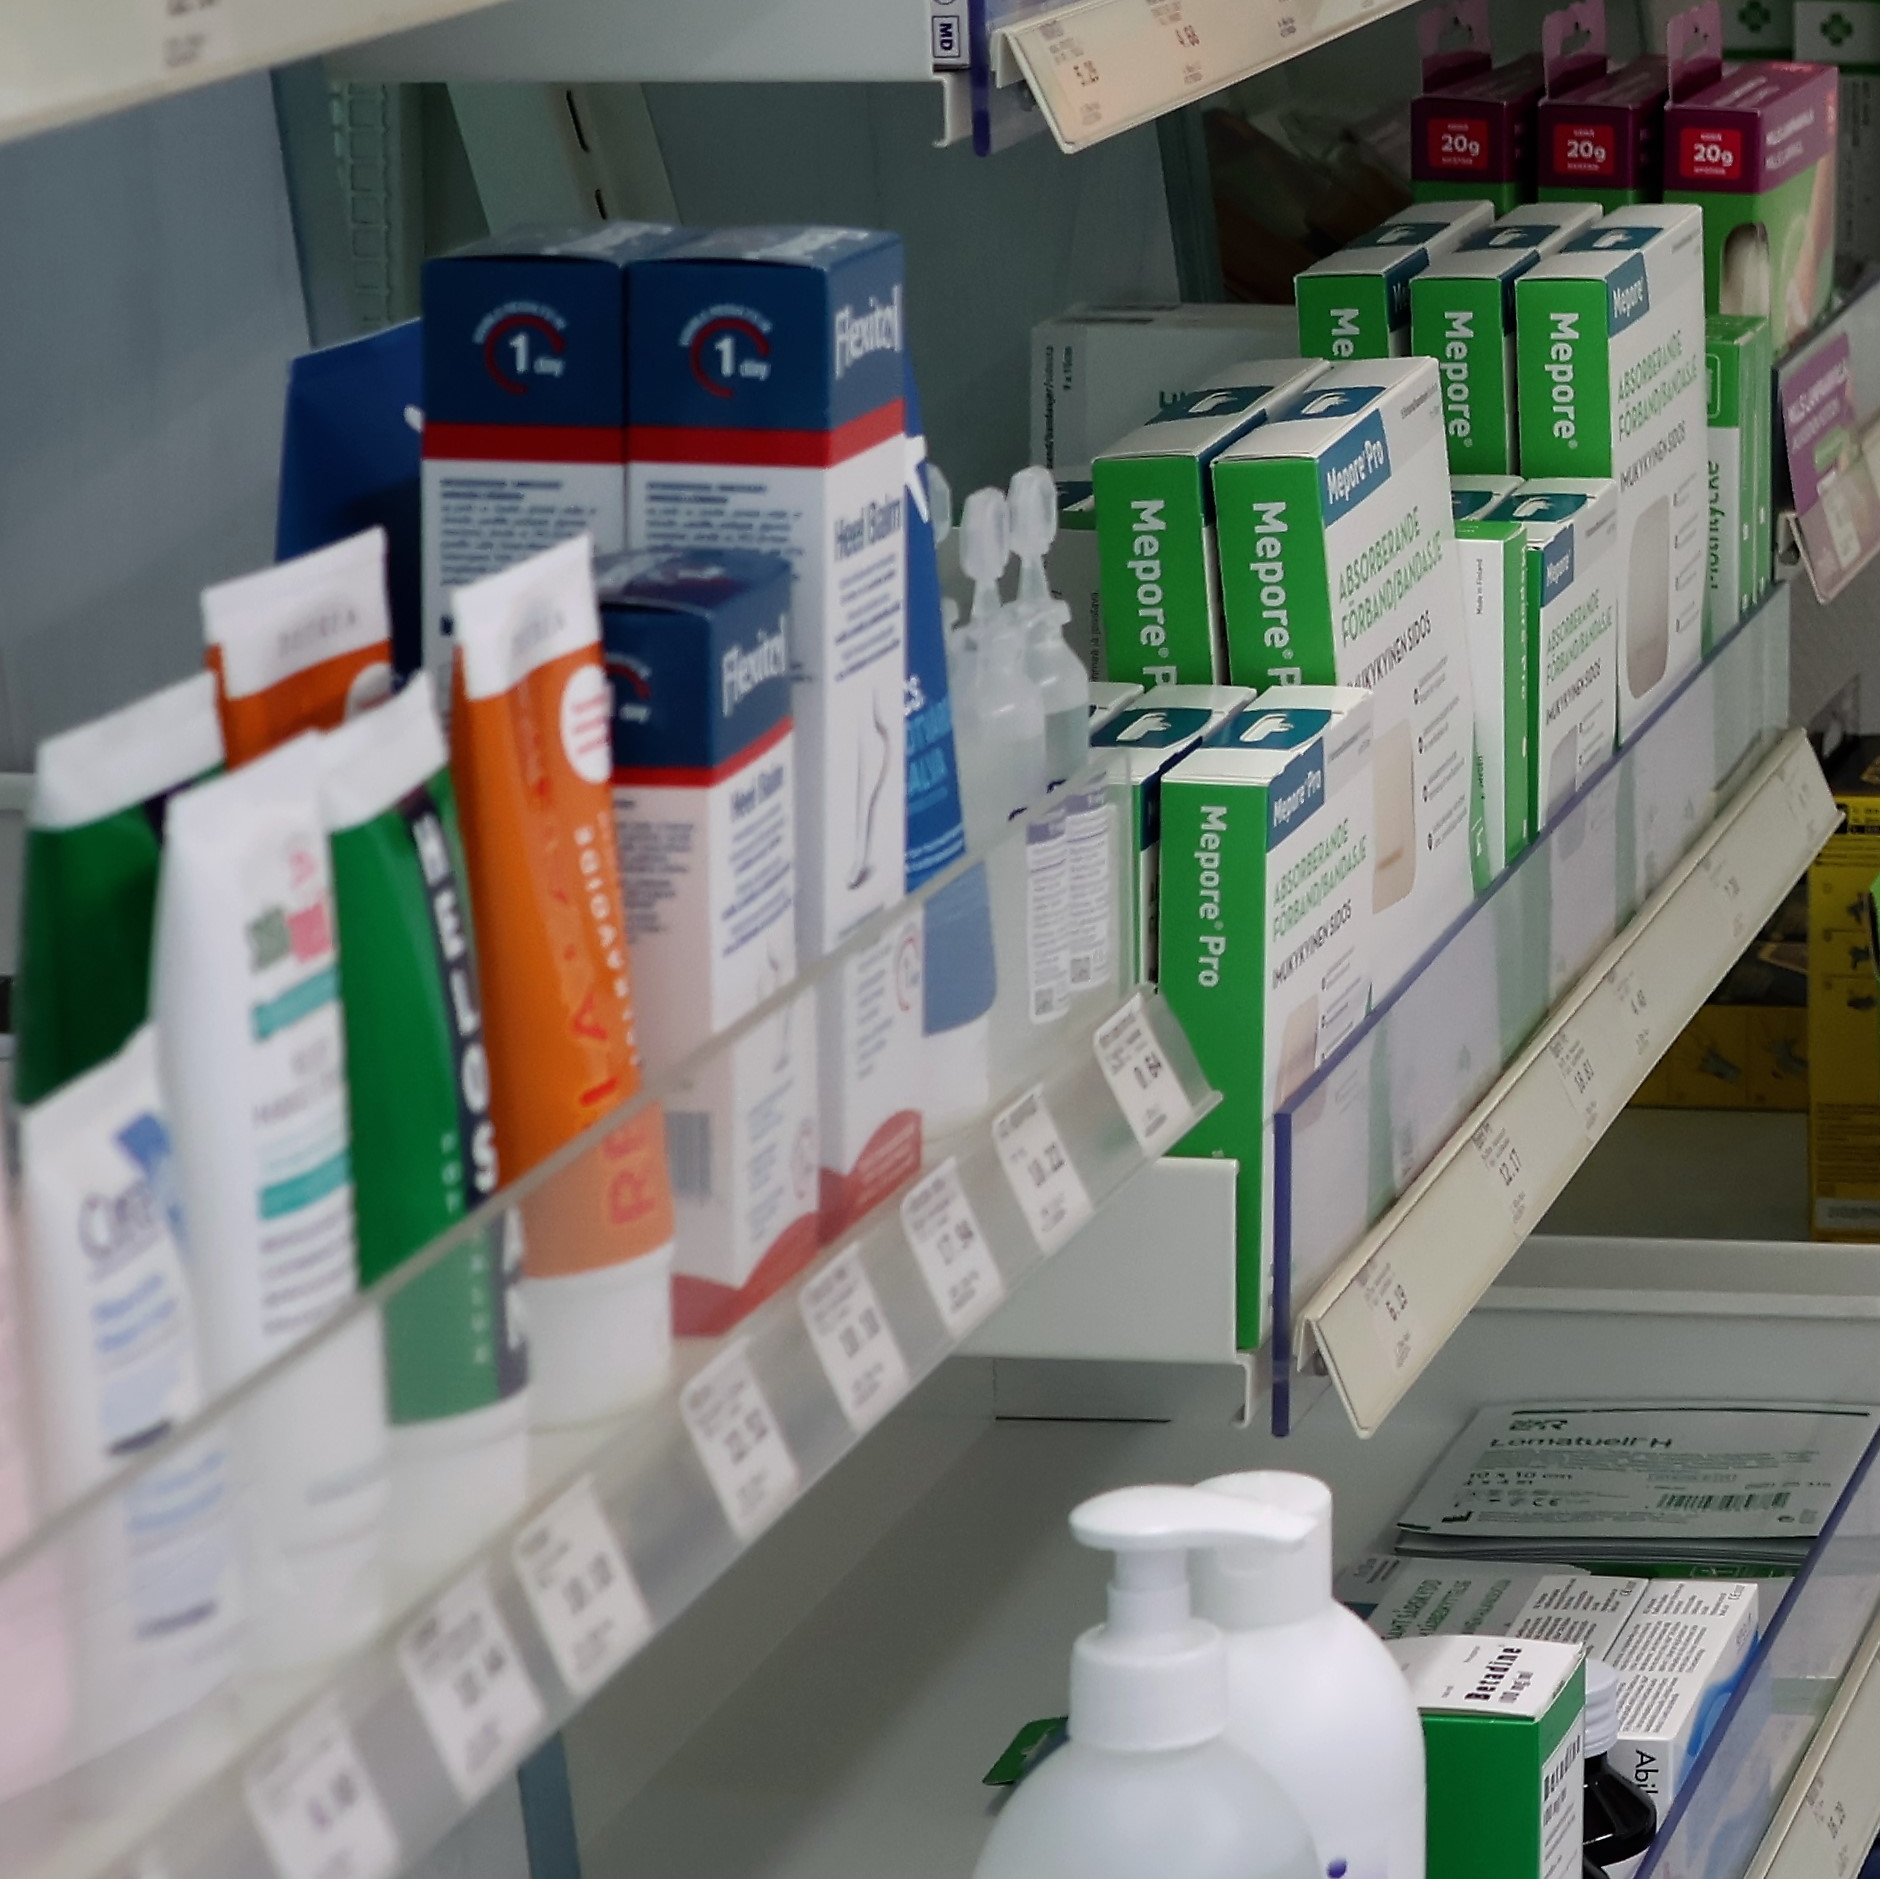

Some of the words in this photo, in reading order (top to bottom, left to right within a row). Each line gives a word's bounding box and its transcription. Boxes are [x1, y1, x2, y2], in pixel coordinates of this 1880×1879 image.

[939, 22, 954, 52] MD
[1440, 133, 1480, 157] 20g
[1566, 139, 1607, 163] 20g
[1693, 143, 1734, 168] 20g
[508, 332, 530, 376] 1
[834, 283, 903, 382] Flexitol
[714, 336, 736, 378] 1
[1618, 328, 1683, 404] ABSORBERANDE
[1364, 439, 1385, 476] Pro
[1338, 505, 1421, 604] ABSORBERANDE
[1476, 558, 1484, 584] Finland
[1341, 529, 1443, 649] FÖRBAND/BANDASJE
[1476, 595, 1484, 615] Made
[1406, 609, 1432, 651] SIDOS
[722, 613, 788, 719] Flexitol
[1273, 817, 1350, 908] ABSORBERANDE
[1197, 933, 1228, 989] Pro
[1649, 1437, 1674, 1448] H
[1464, 1646, 1523, 1701] Betadine
[1543, 1734, 1582, 1802] Betadine
[1633, 1748, 1659, 1795] Abil
